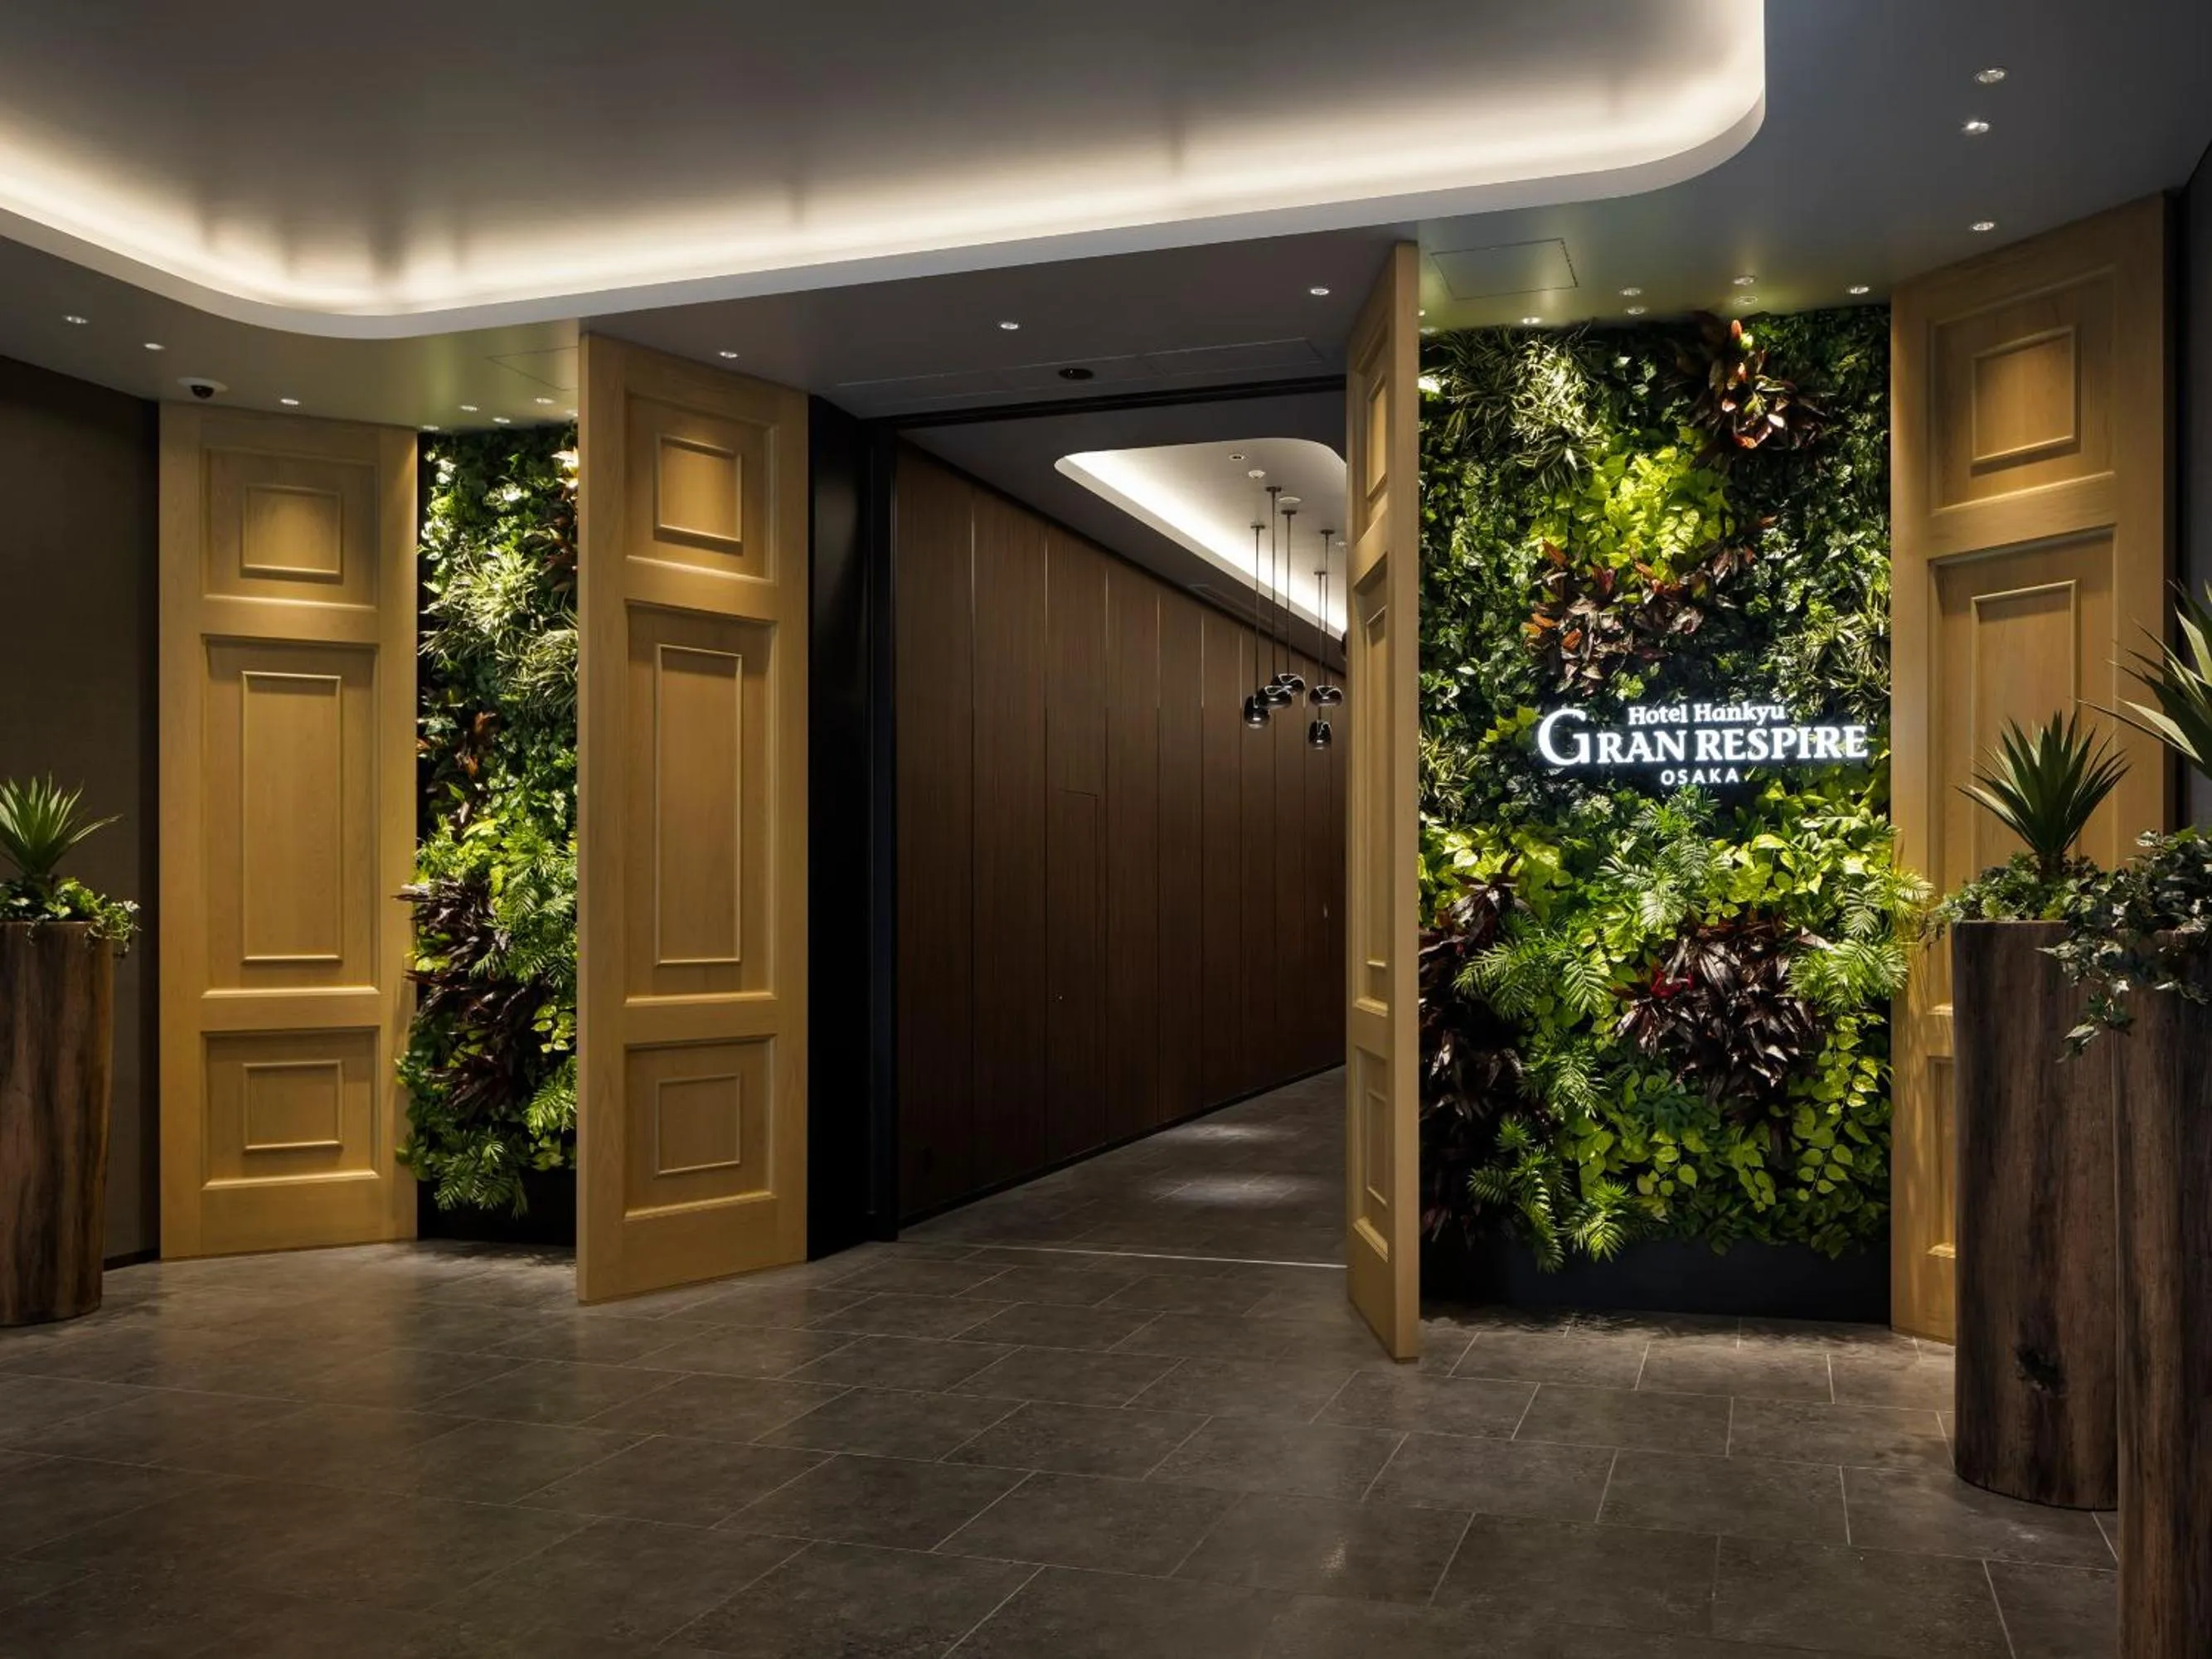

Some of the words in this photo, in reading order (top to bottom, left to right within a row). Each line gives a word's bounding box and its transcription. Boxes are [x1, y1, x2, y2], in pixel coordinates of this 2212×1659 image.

[1627, 704, 1688, 725] Hotel
[1693, 701, 1786, 726] Hankyu
[1537, 707, 1687, 766] GRAN
[1694, 725, 1868, 761] RESPIRE
[1661, 768, 1739, 785] OSAKA
